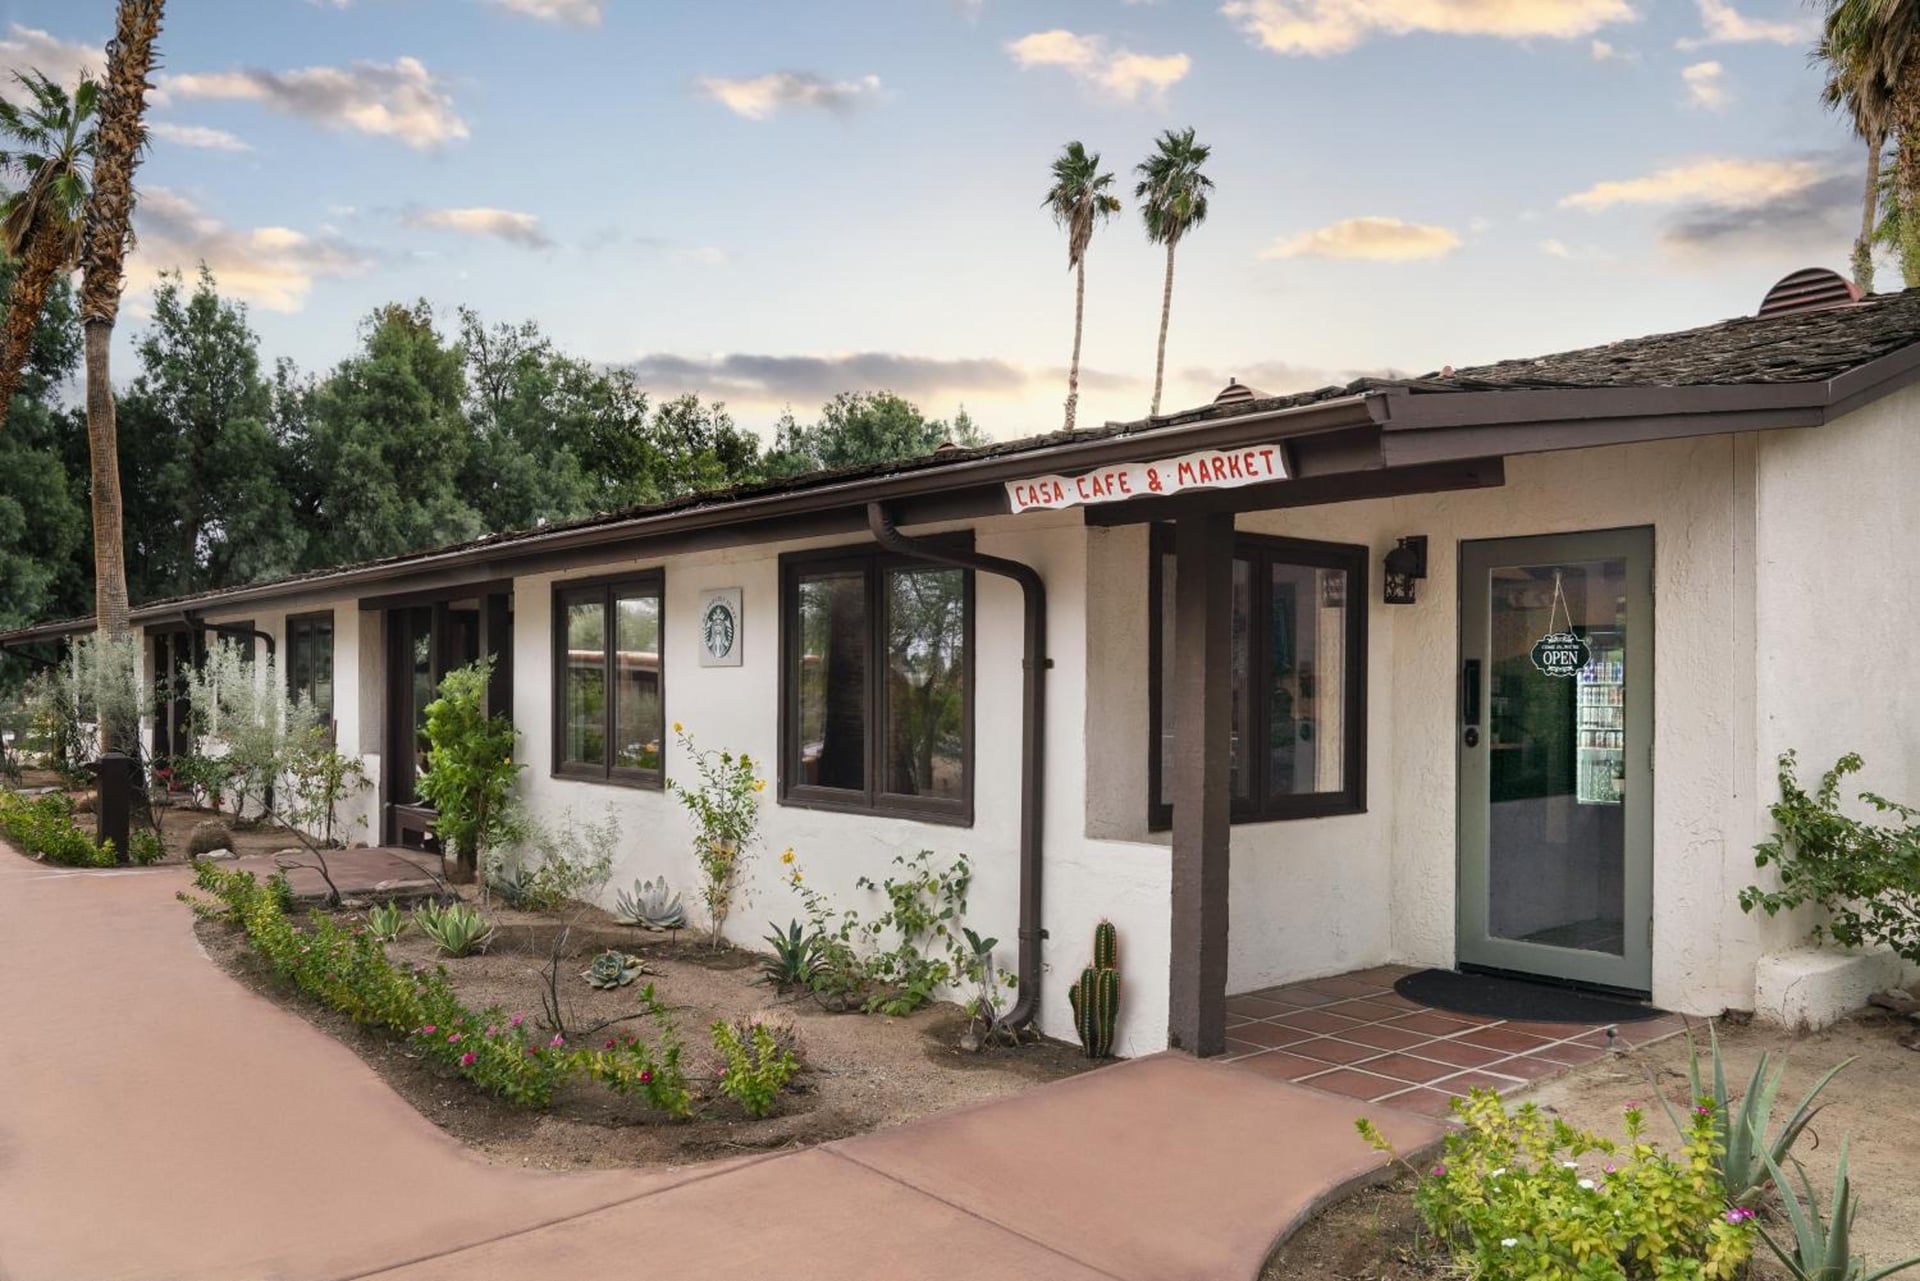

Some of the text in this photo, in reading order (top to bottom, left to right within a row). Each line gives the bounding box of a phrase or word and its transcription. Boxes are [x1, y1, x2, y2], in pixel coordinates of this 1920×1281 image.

[1015, 449, 1274, 507] CASA CAFE & MARKET
[1542, 650, 1578, 665] OPEN
